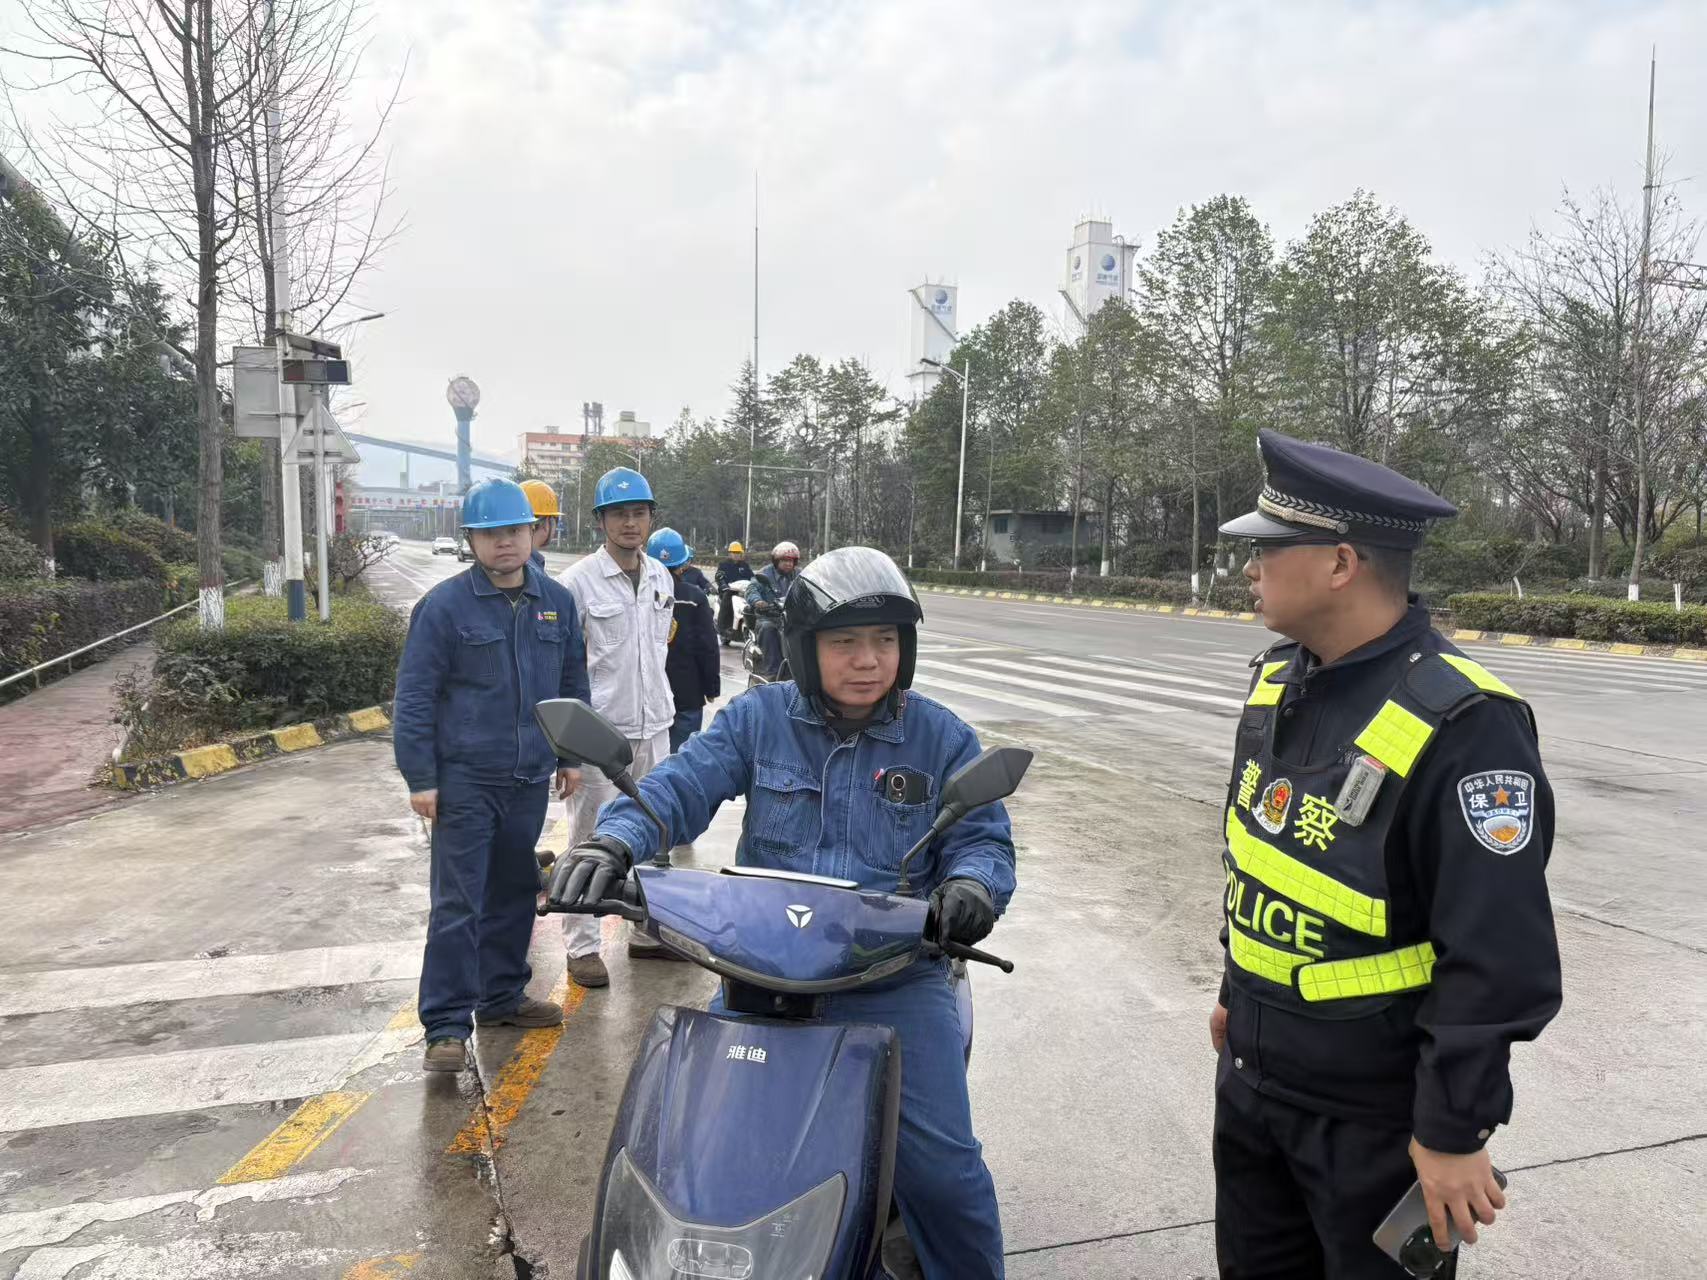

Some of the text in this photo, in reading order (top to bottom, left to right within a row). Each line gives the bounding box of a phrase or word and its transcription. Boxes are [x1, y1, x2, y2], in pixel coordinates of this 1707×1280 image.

[1464, 774, 1529, 793] 中华人民共和国
[1237, 759, 1262, 811] 警
[1294, 793, 1342, 851] 察
[1469, 791, 1528, 809] 保 卫
[726, 1044, 767, 1064] 雅迪
